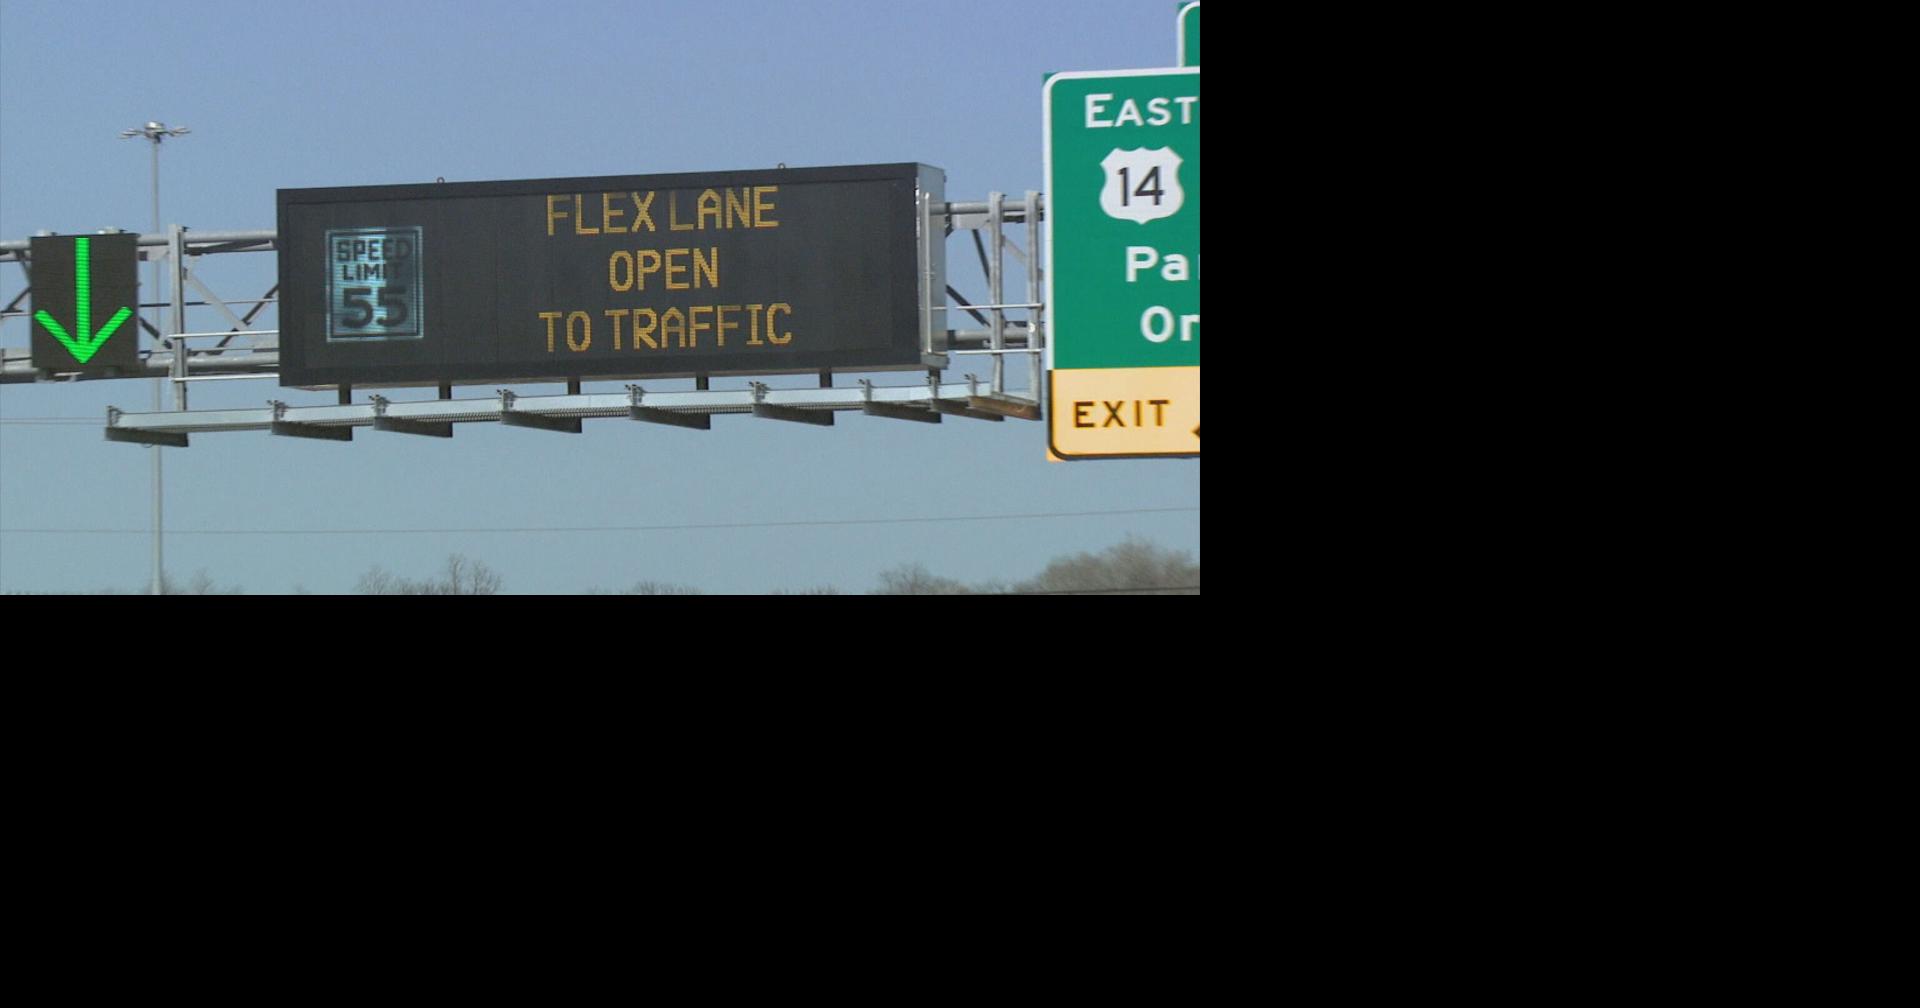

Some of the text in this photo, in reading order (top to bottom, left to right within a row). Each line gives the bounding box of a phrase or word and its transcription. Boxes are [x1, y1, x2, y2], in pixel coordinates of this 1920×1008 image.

[1085, 93, 1199, 128] EAST
[1117, 166, 1164, 207] 14
[547, 185, 779, 236] FLEX LANE
[336, 239, 411, 261] SPEED
[1125, 246, 1200, 282] Pa
[342, 262, 403, 281] LIMIT
[608, 247, 719, 292] OPEN
[341, 285, 409, 329] 55
[538, 302, 792, 352] TO TRAFFIC
[1074, 399, 1170, 428] EXIT
